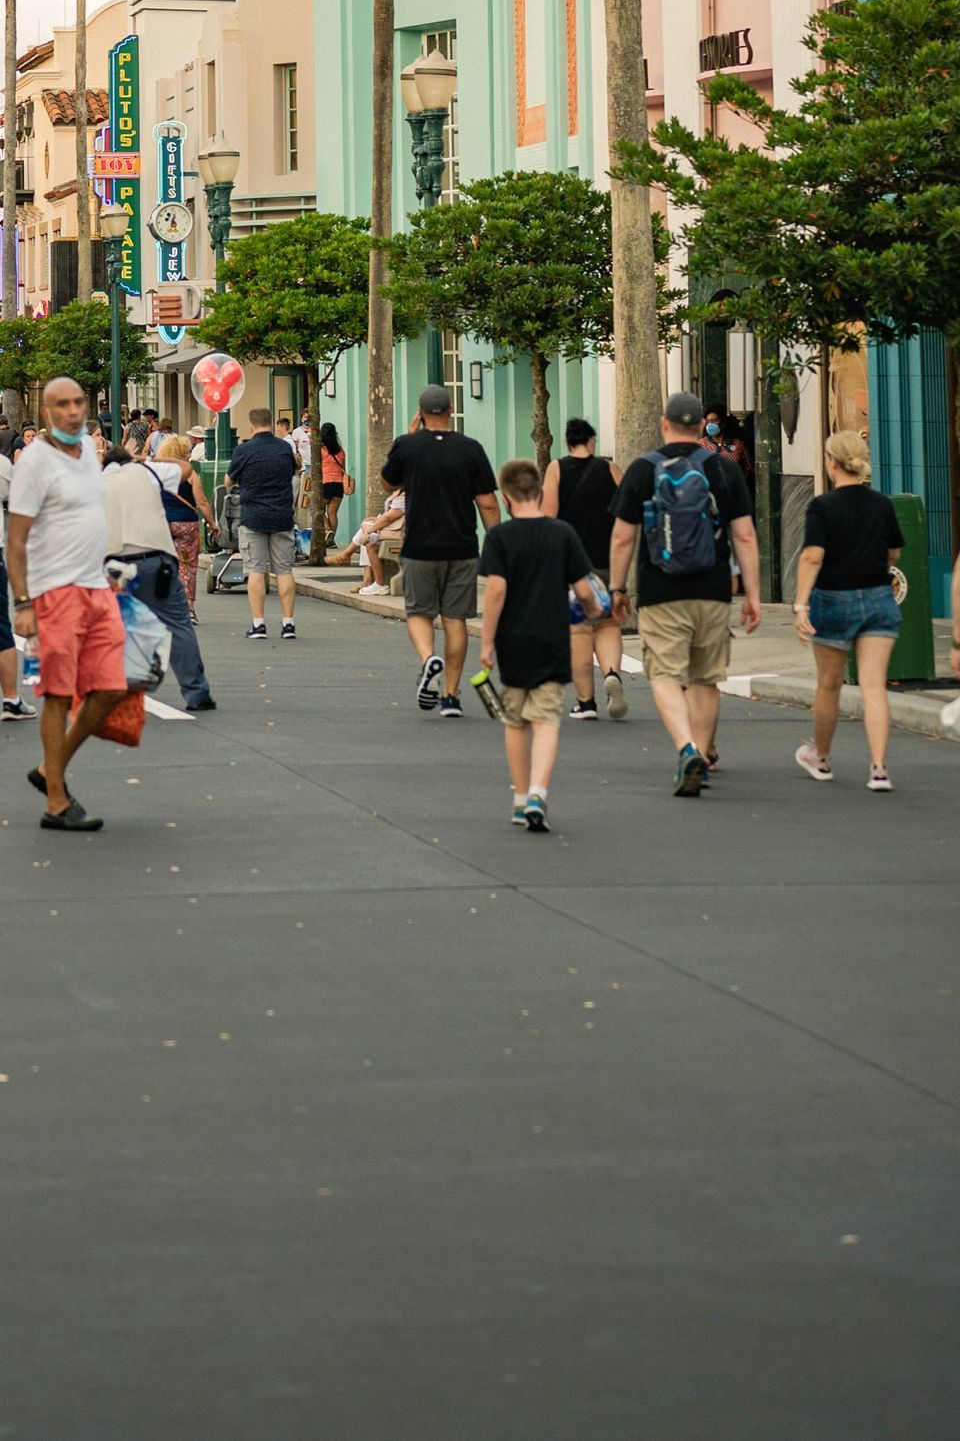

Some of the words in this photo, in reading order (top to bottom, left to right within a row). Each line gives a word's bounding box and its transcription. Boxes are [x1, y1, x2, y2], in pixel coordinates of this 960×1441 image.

[118, 52, 137, 147] PLUTO'S
[99, 158, 136, 171] TOY
[166, 141, 178, 199] GIFTS
[120, 187, 134, 279] PAACE
